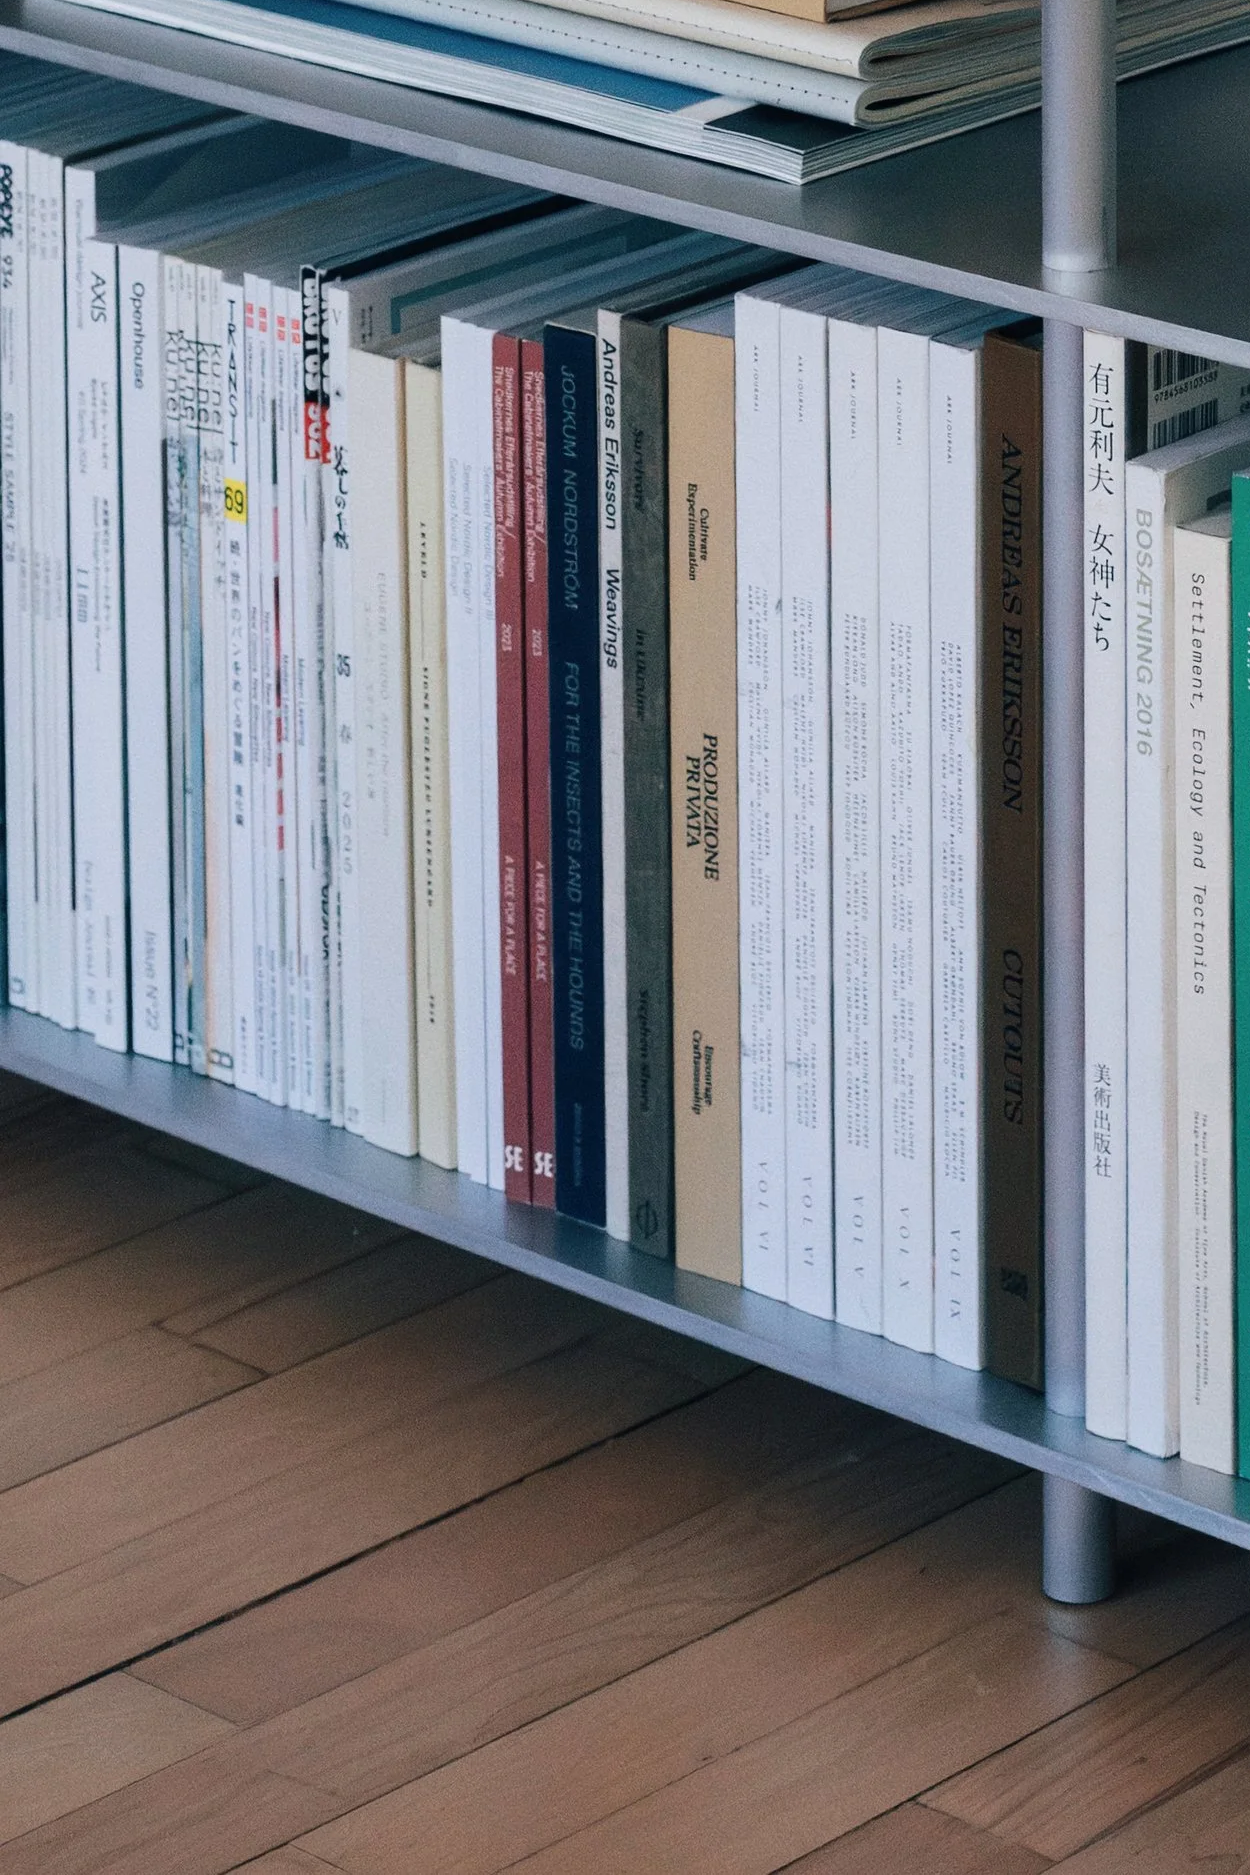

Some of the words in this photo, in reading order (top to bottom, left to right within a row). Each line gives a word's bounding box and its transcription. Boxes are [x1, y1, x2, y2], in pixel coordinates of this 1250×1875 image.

[91, 271, 107, 323] AXIS
[131, 282, 148, 390] Openhouse
[303, 276, 320, 393] BRUTUS
[228, 299, 240, 464] TRANSIT
[525, 371, 534, 390] The
[561, 365, 577, 456] JOCKUM
[601, 338, 618, 429] Andreas
[1089, 363, 1115, 495] 有元利夫
[224, 486, 244, 514] 69
[482, 465, 493, 518] Selected
[526, 482, 535, 526] Autumn
[603, 436, 620, 530] Eriksson
[1001, 433, 1023, 614] ANDREAS
[483, 522, 494, 560] Nordic
[527, 528, 536, 582] Exhibition
[562, 469, 582, 611] NORDSTRÖM
[686, 482, 699, 581] Experimentation
[698, 507, 710, 561] Cultivate
[603, 568, 621, 669] Weavings
[1089, 524, 1115, 651] 女神たち
[1135, 508, 1153, 684] BOSÆTNING
[564, 662, 580, 707] FOR
[1189, 573, 1205, 710] Settlement,
[565, 713, 581, 753] THE
[1002, 622, 1023, 813] ERIKSSON
[1136, 692, 1153, 757] 2016
[565, 760, 582, 851] INSECTS
[686, 754, 701, 849] PRIVATA
[702, 732, 720, 882] PRODUZIONE
[1189, 728, 1206, 817] Ecology
[566, 856, 582, 902] AND
[1192, 831, 1206, 868] and
[143, 930, 158, 979] Issue
[567, 911, 583, 952] THE
[1192, 884, 1207, 994] Tectonics
[568, 956, 584, 1050] HOUNDS
[1003, 950, 1024, 1124] CUTOUTS
[690, 1029, 704, 1115] Craftsmanship
[703, 1045, 715, 1106] Encourage
[1094, 1063, 1113, 1179] 美術出版社
[948, 1228, 961, 1277] VOL
